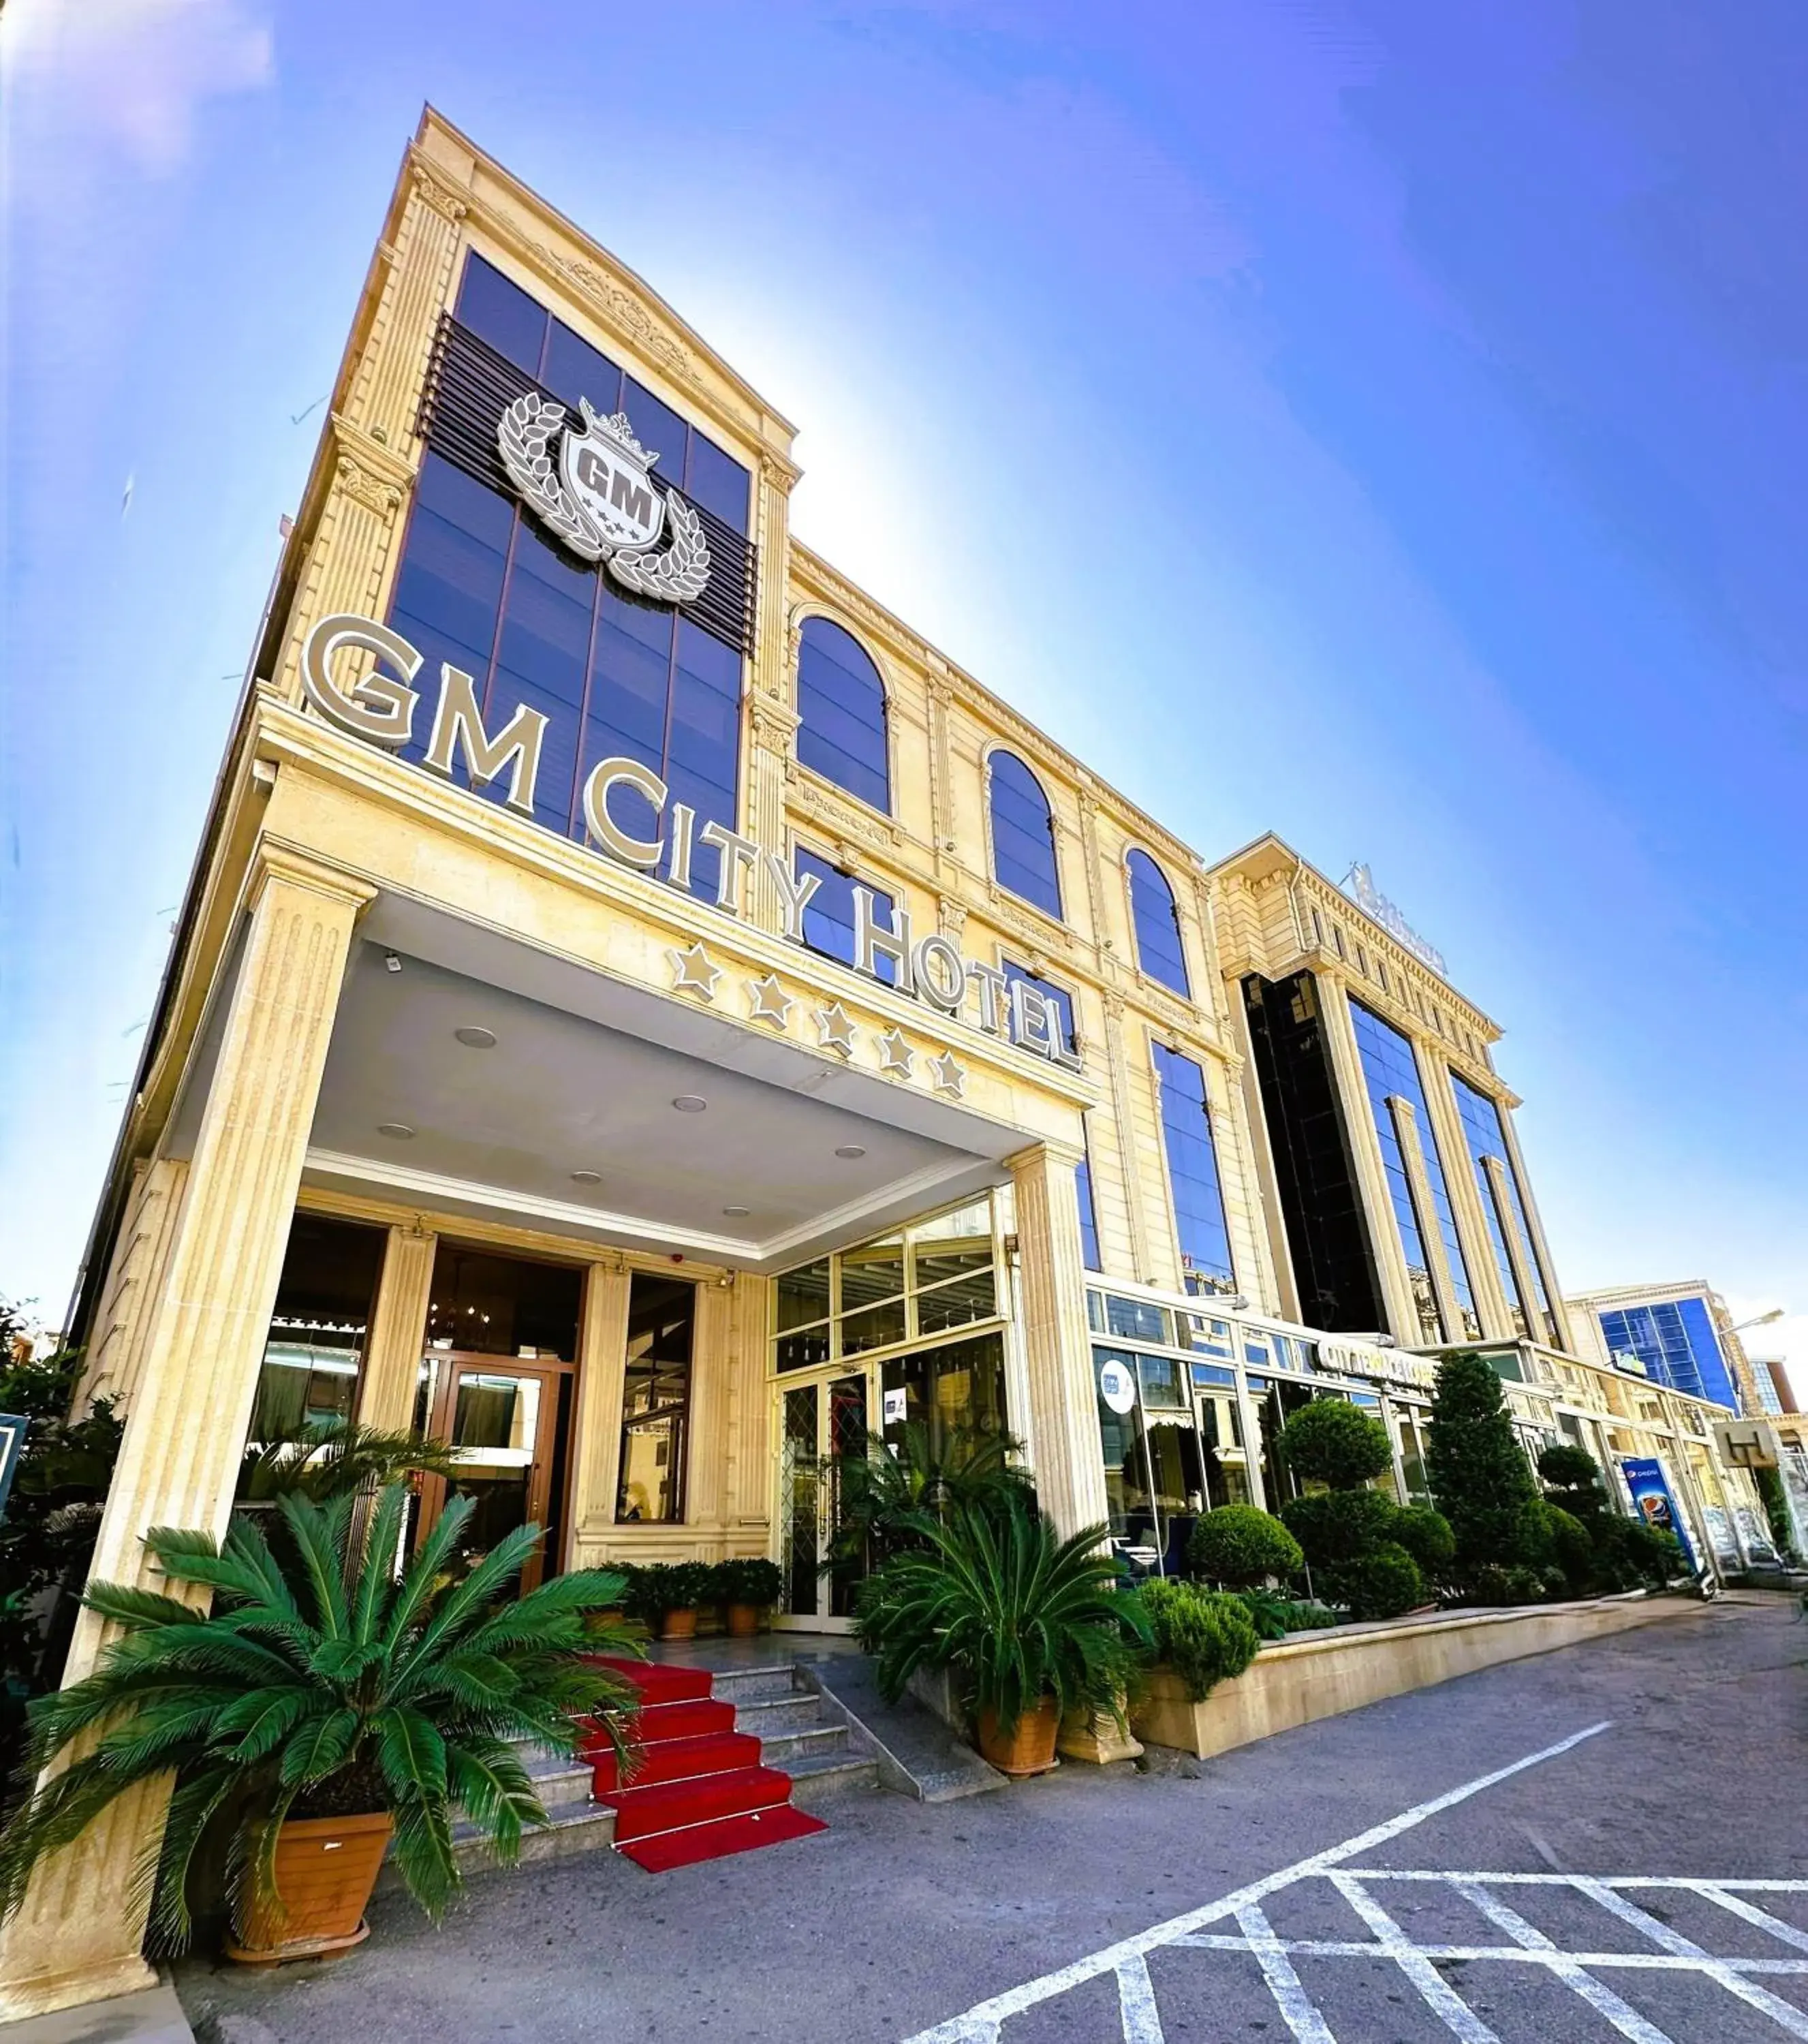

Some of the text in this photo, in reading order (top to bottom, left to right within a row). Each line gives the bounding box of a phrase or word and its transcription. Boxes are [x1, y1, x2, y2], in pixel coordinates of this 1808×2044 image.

[578, 448, 653, 530] GM
[301, 614, 1082, 1072] GM CITY HOTEL
